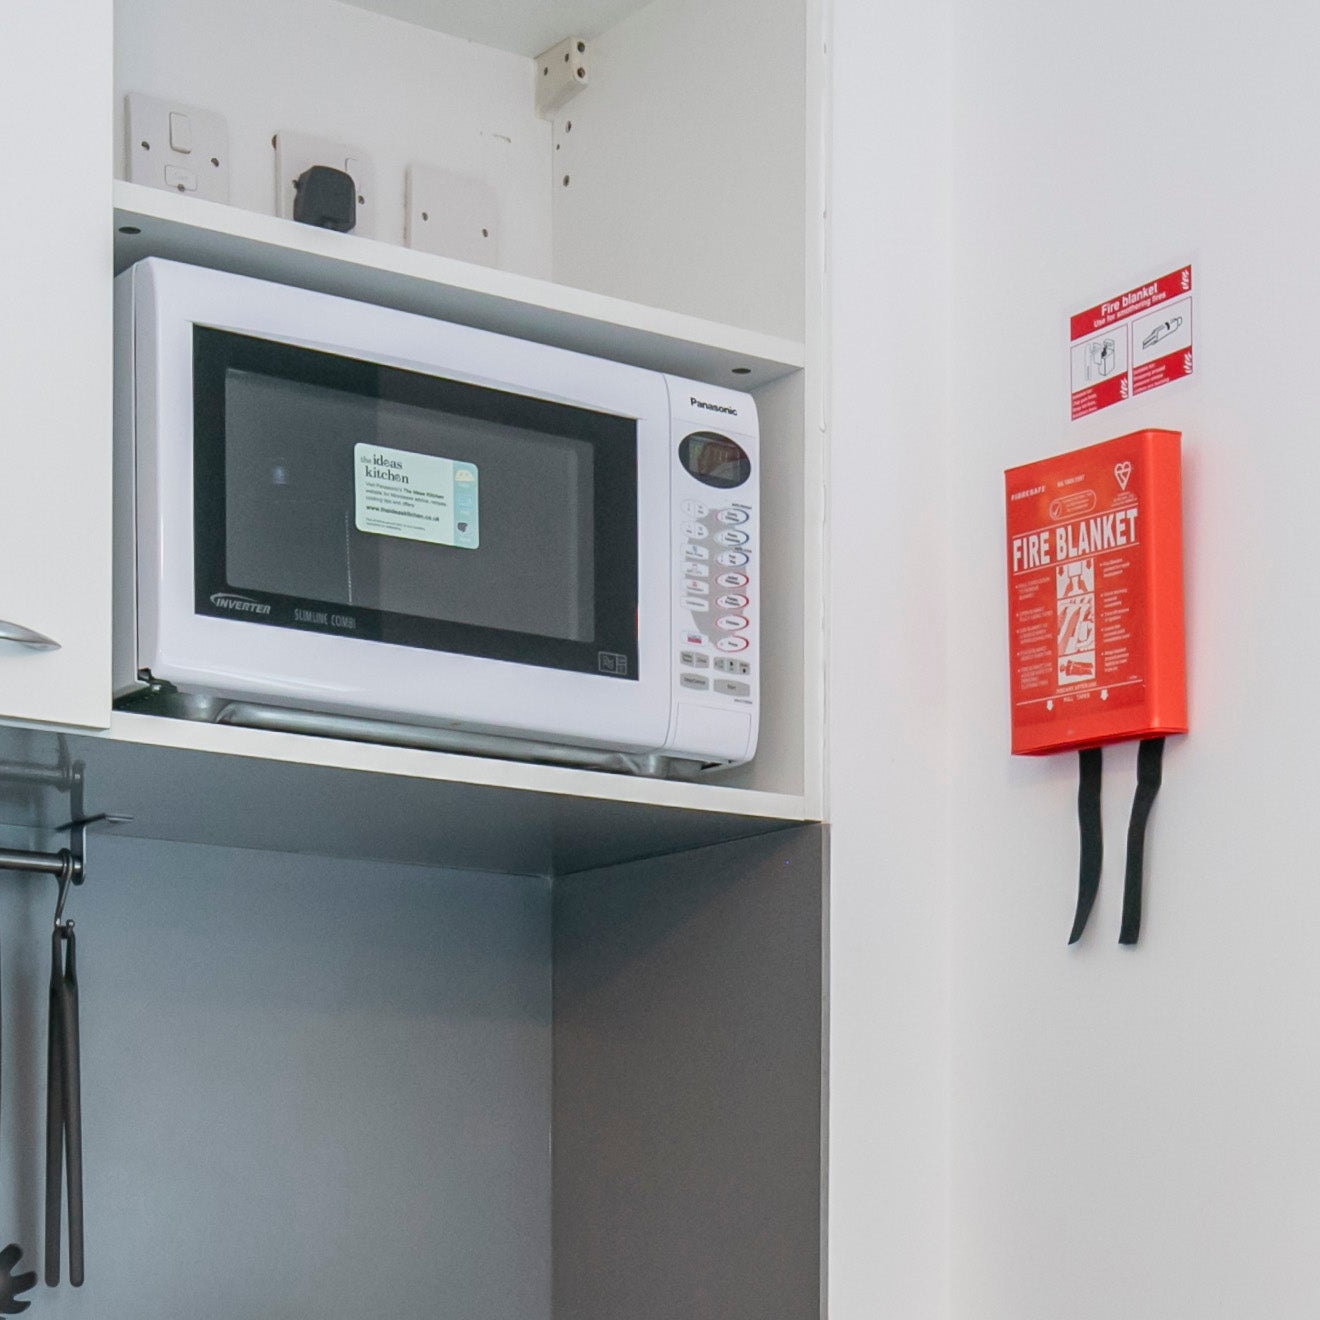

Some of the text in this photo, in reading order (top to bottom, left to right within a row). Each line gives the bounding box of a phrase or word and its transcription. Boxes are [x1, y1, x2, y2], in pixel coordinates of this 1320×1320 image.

[1101, 282, 1158, 316] Fire blanket
[690, 397, 738, 416] Panasonic
[360, 454, 403, 470] the ideas
[365, 466, 409, 484] kitchen
[1013, 531, 1050, 572] FIRE
[1056, 508, 1139, 561] BLANKET
[215, 598, 272, 615] INVERTER
[294, 608, 357, 629] SLIMLINE COMBI
